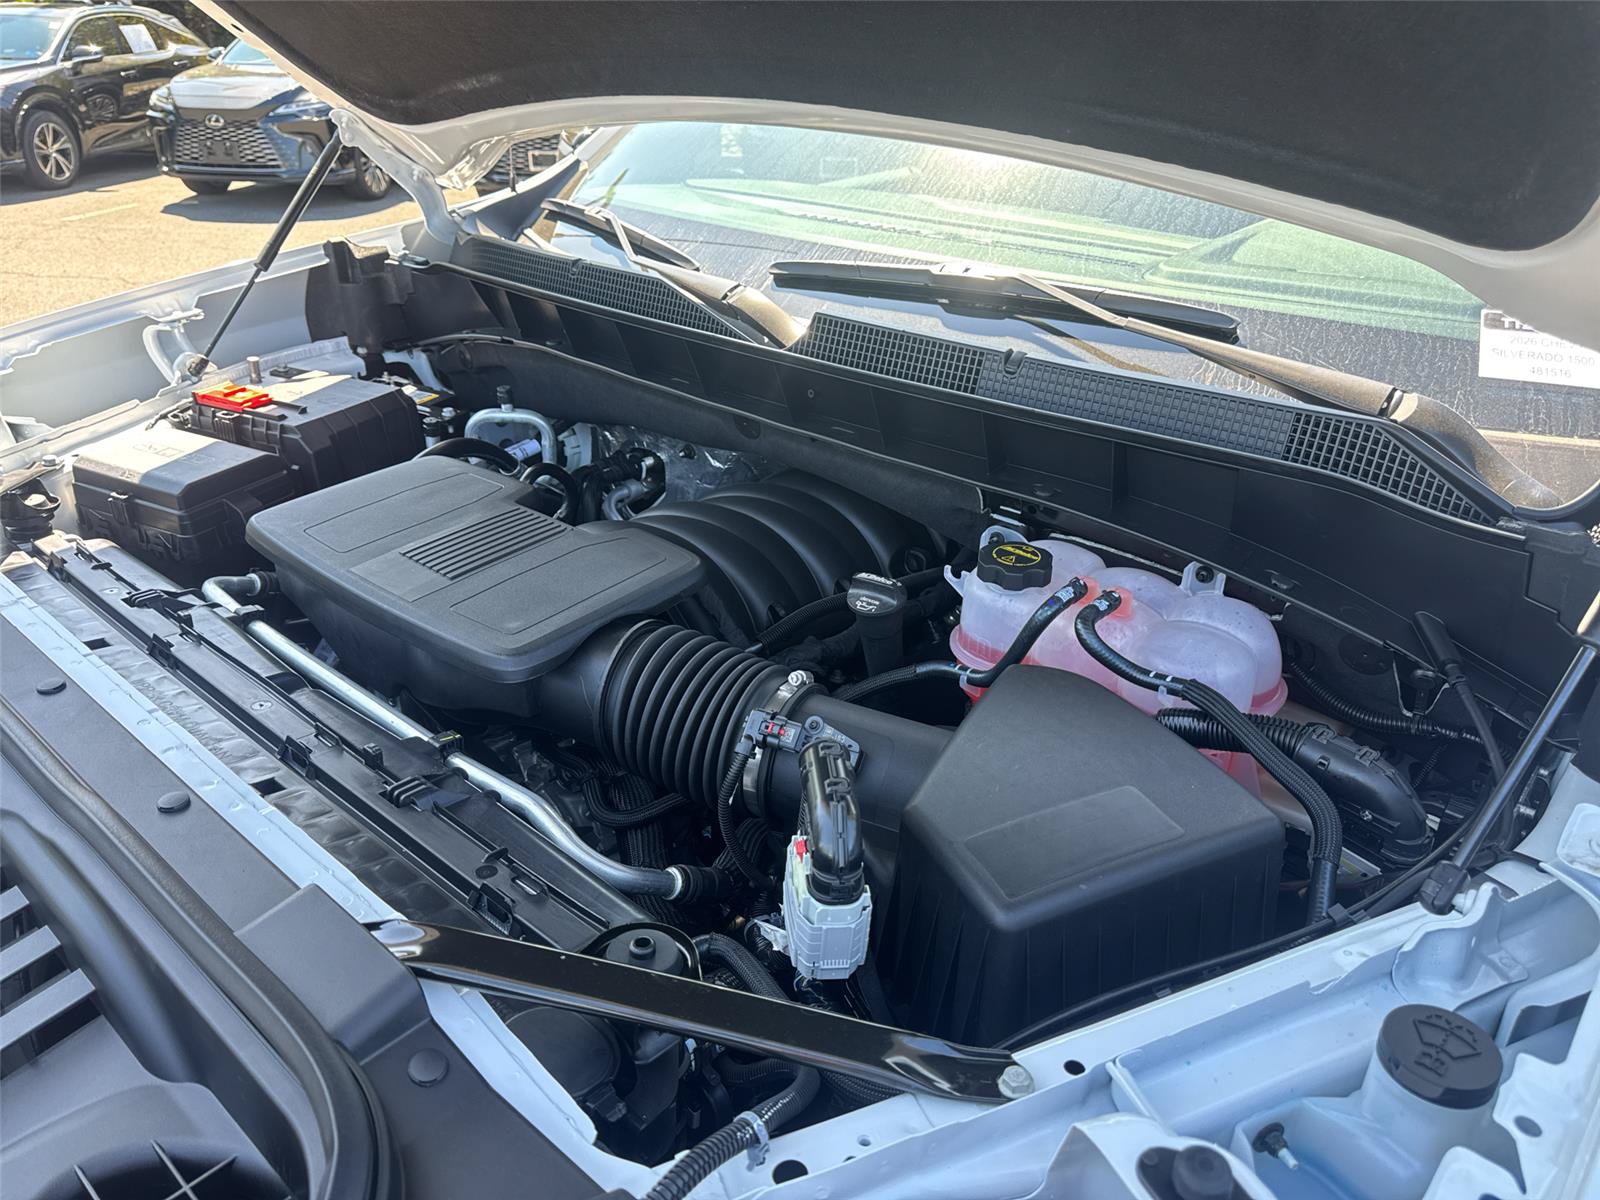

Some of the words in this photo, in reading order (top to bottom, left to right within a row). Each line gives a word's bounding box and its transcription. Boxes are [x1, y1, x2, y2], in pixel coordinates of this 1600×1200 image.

[1509, 334, 1538, 347] 2026
[1491, 347, 1564, 364] SILVERADO
[1568, 354, 1596, 368] 1500
